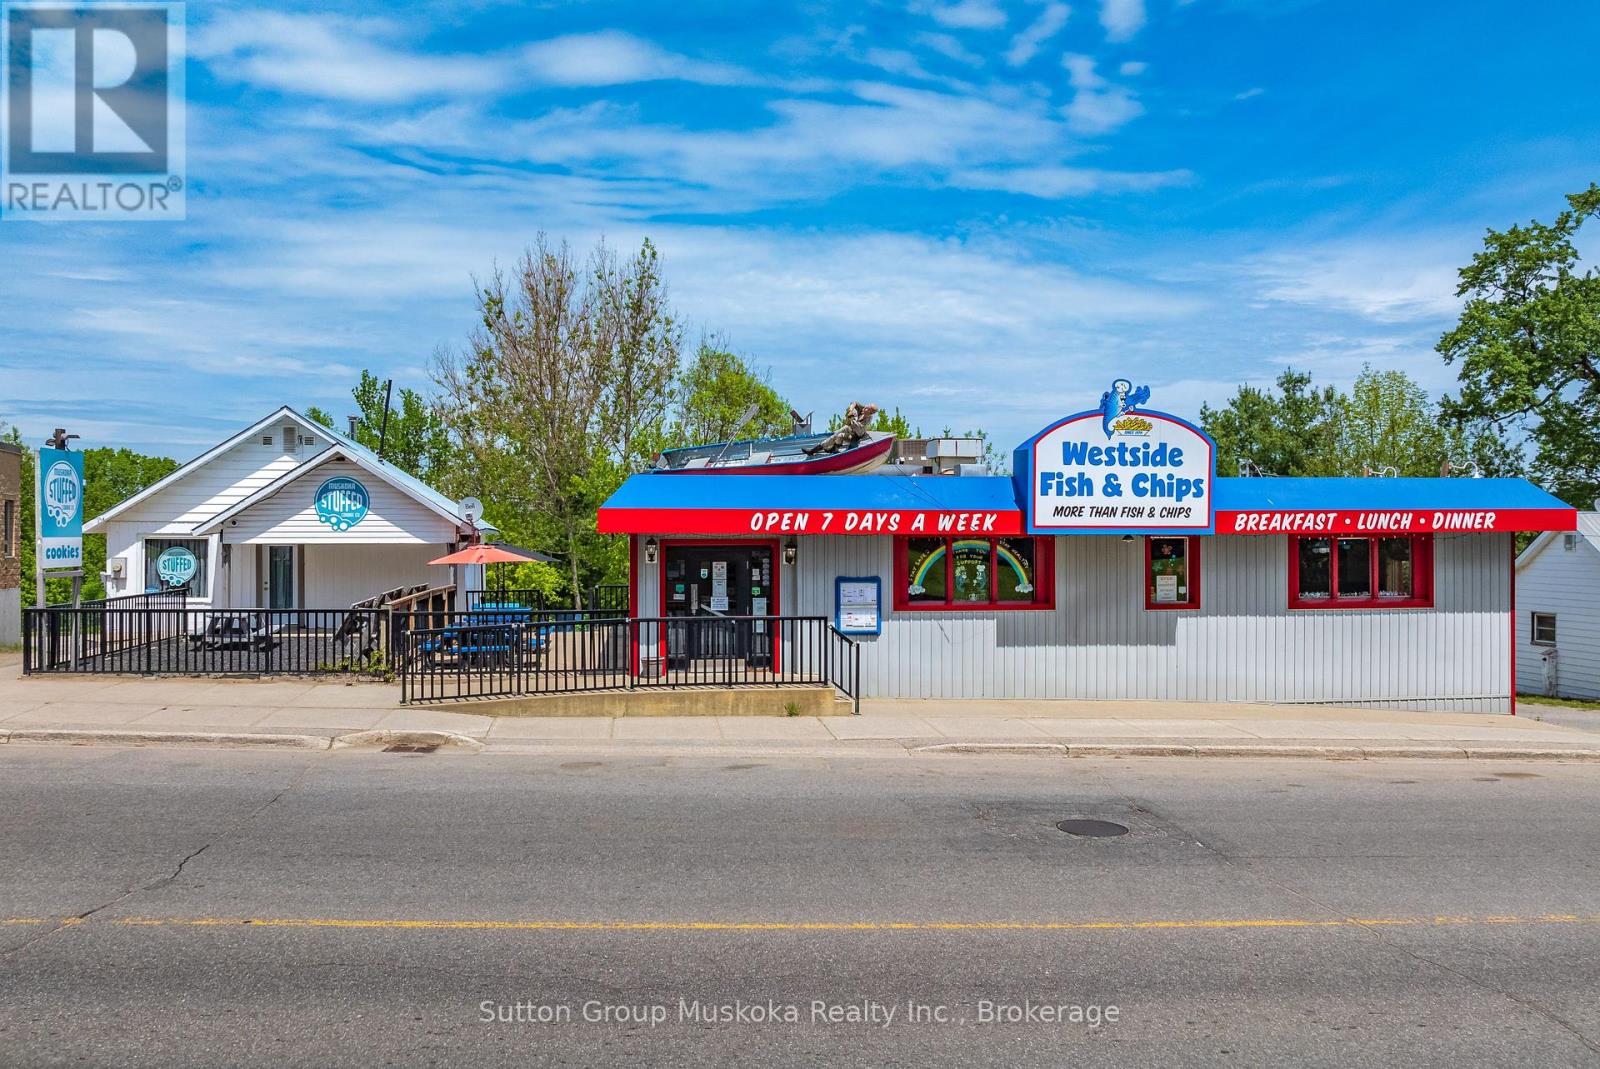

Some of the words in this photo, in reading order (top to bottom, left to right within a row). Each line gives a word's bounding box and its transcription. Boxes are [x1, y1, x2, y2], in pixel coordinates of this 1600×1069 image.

[1062, 441, 1184, 467] Westside
[49, 478, 76, 504] STUFFED
[1040, 472, 1094, 497] Fish
[1102, 473, 1123, 498] &
[1131, 472, 1204, 502] Chips
[321, 490, 363, 512] STUFFED
[750, 512, 809, 530] OPEN
[821, 512, 834, 530] 7
[844, 512, 901, 531] DAYS
[911, 513, 925, 531] A
[937, 513, 998, 531] WEEK
[1053, 506, 1085, 519] MORE
[1089, 506, 1118, 519] THAN
[1120, 506, 1144, 519] FISH
[1147, 507, 1156, 518] &
[1159, 507, 1192, 519] CHIPS
[1234, 513, 1337, 531] BREAKFAST
[1356, 513, 1413, 530] LUNCH
[1431, 512, 1497, 530] DINNER
[45, 545, 79, 560] cookies
[162, 557, 191, 573] STUFFED
